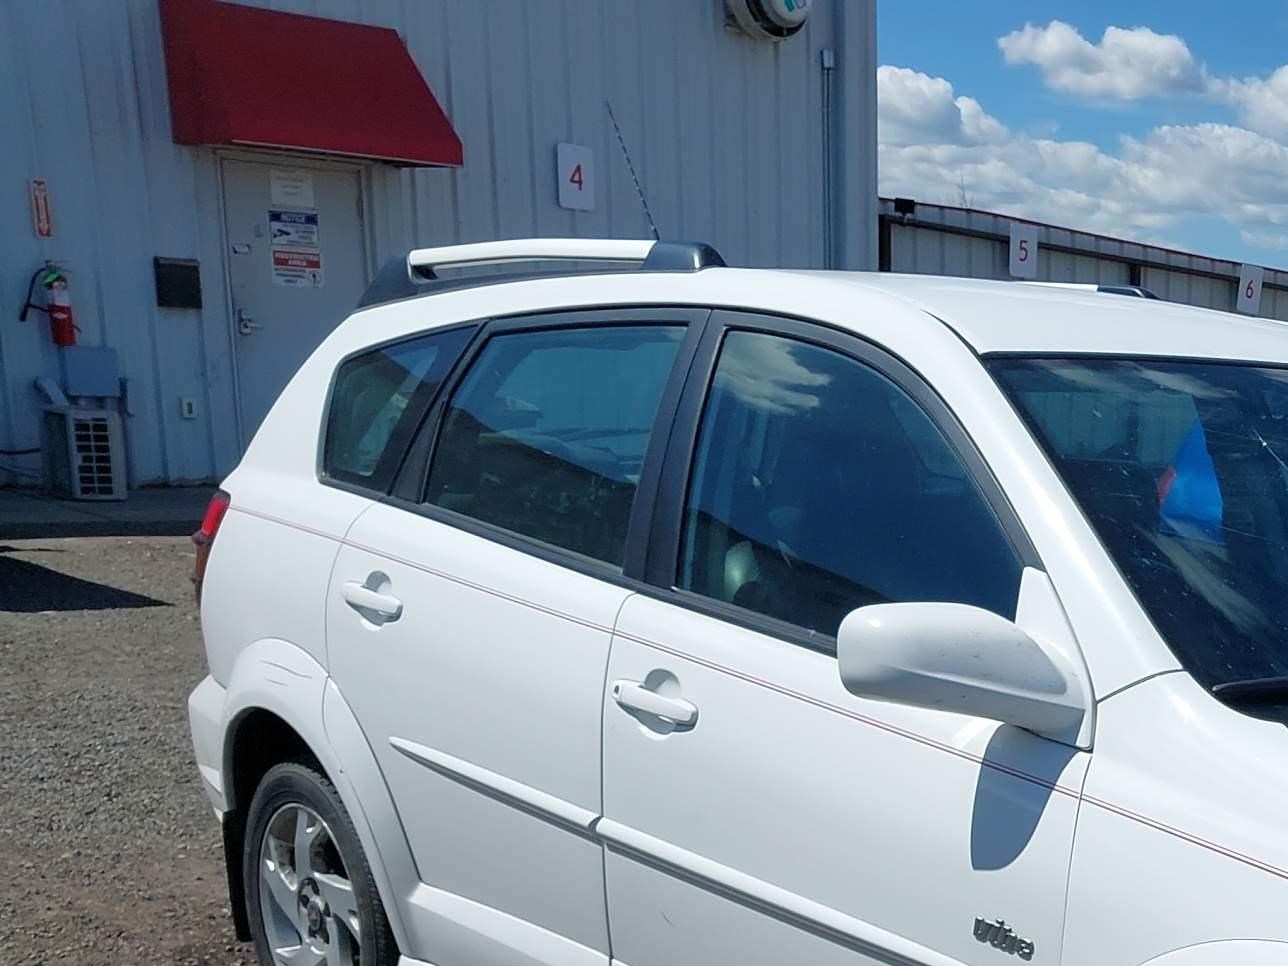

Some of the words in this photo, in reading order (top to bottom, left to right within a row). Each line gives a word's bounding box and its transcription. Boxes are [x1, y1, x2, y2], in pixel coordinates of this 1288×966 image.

[569, 163, 584, 192] 4
[1018, 239, 1029, 262] 5
[1245, 279, 1255, 299] 6
